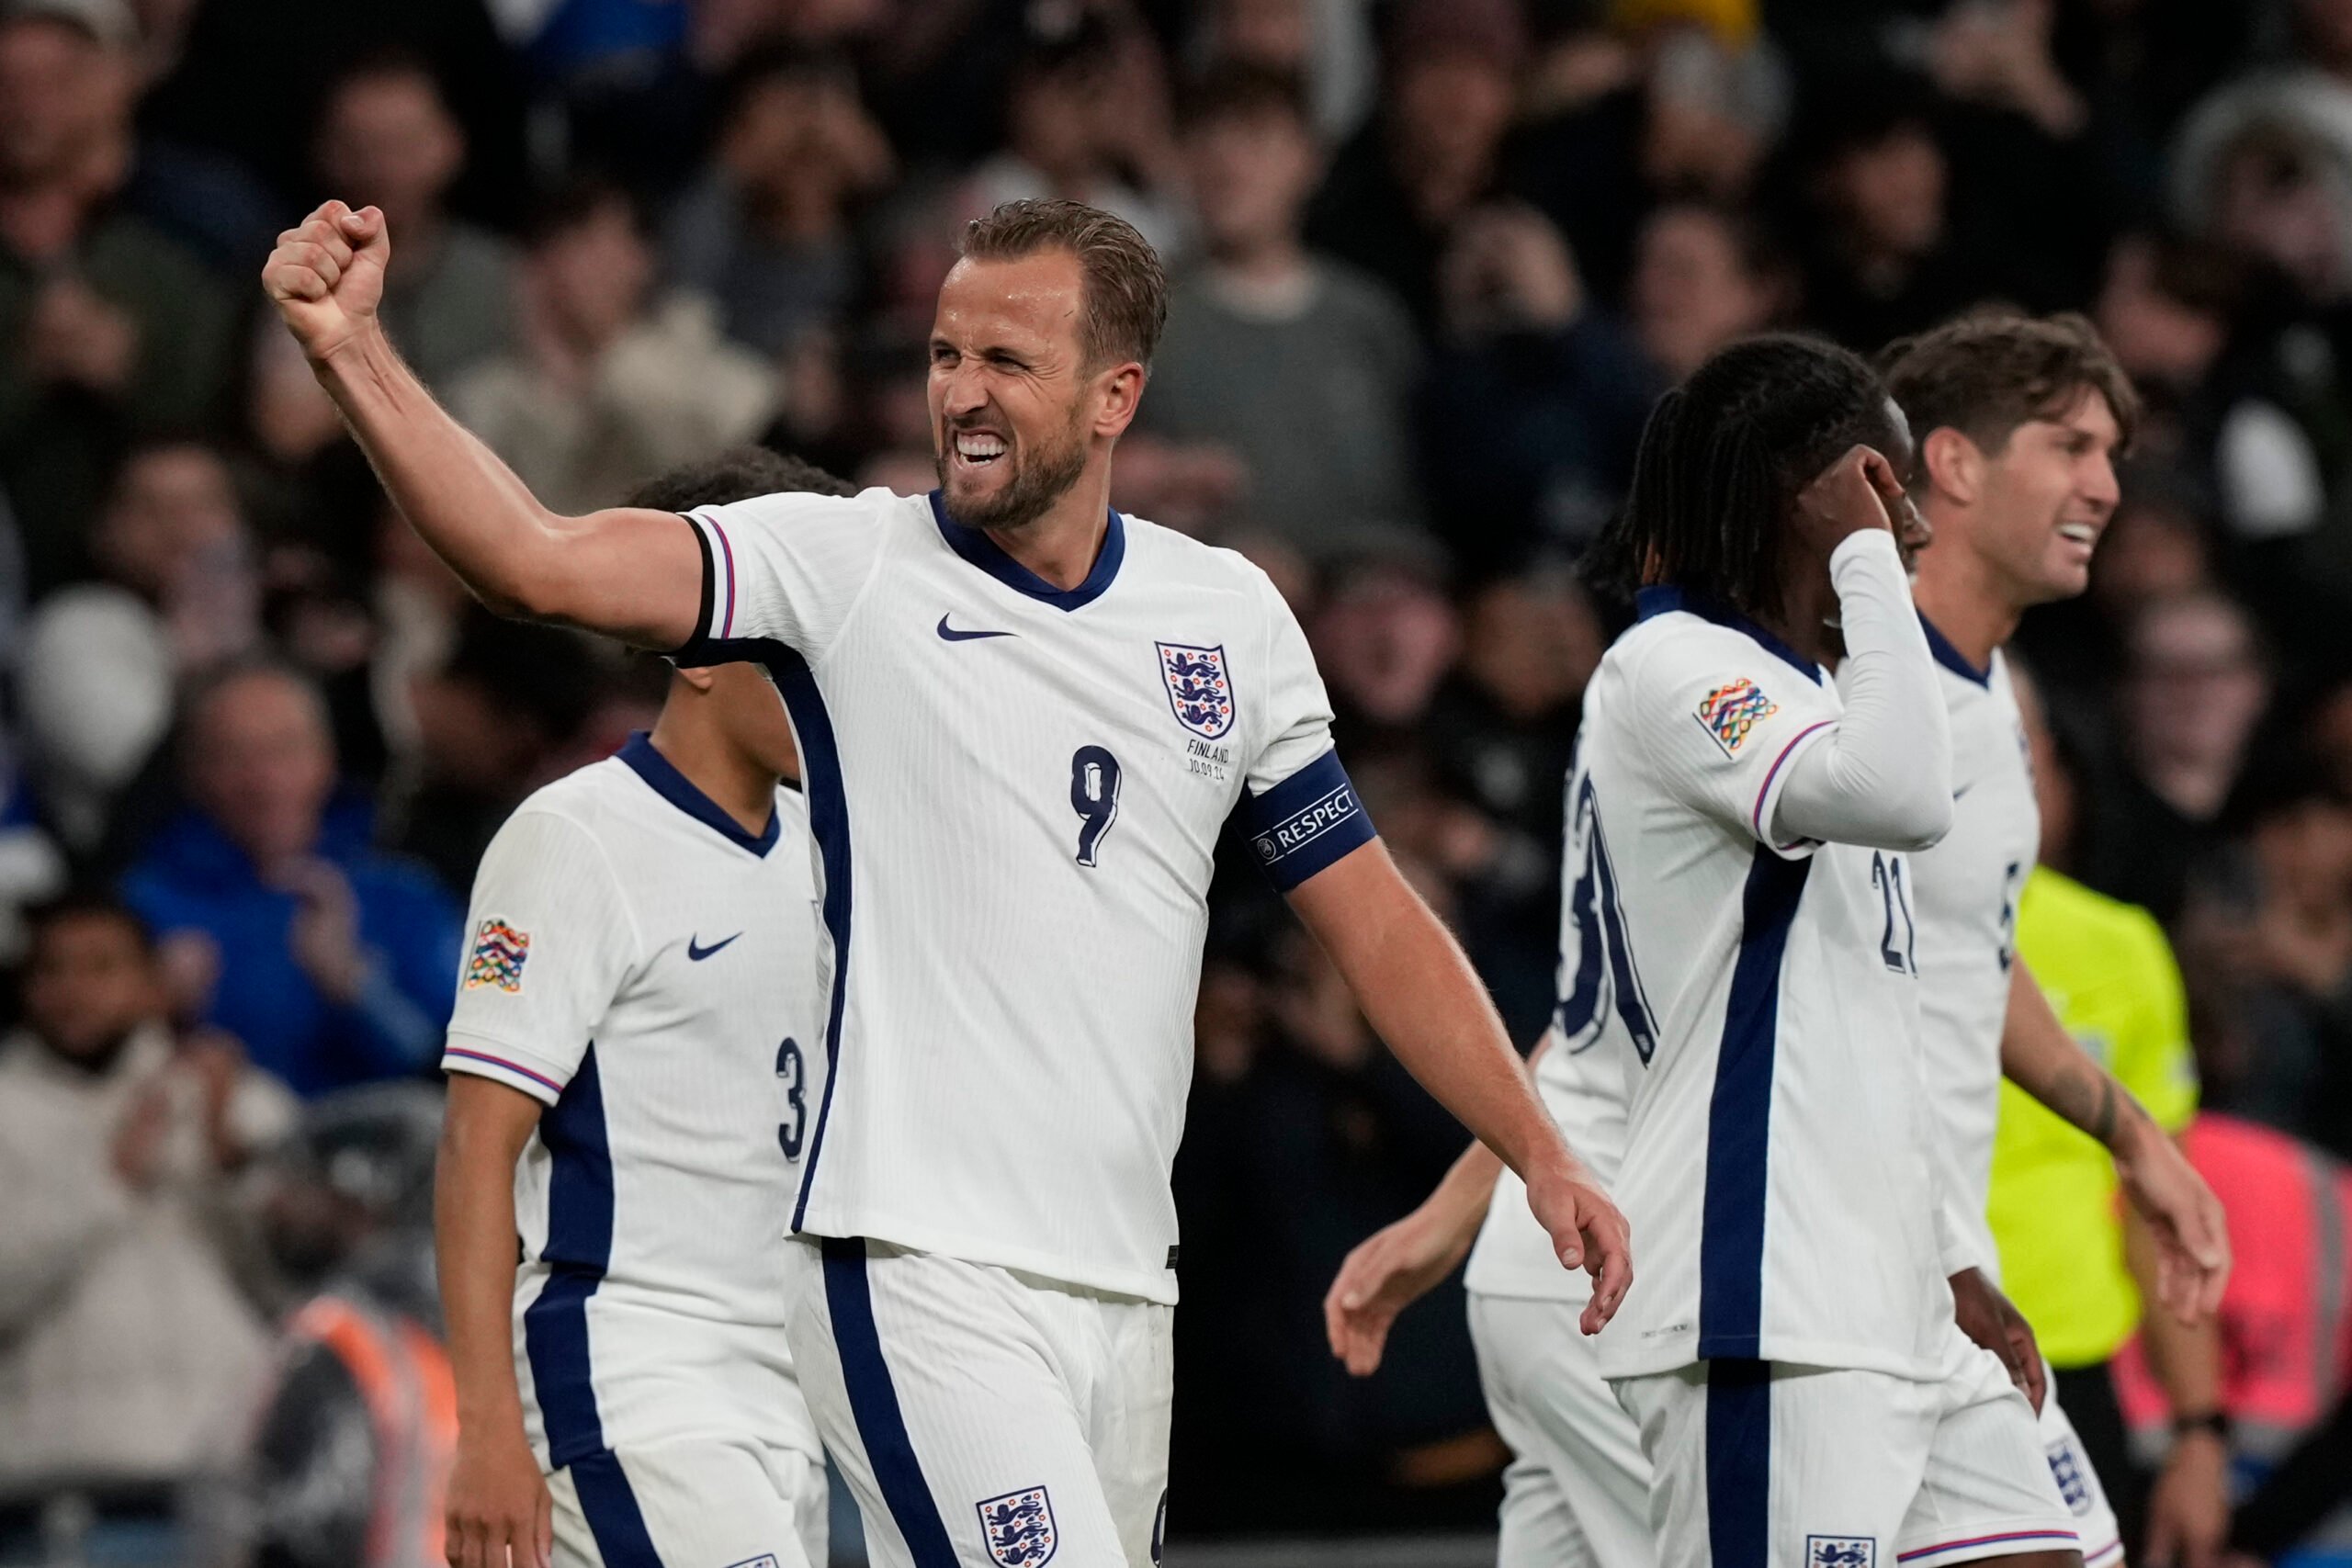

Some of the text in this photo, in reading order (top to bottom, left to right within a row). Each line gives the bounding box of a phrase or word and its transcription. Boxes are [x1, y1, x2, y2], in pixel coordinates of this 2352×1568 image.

[1186, 739, 1229, 763] FINLAND
[1070, 745, 1122, 868] 9
[1276, 790, 1354, 848] RESPECT
[775, 1036, 807, 1163] 3
